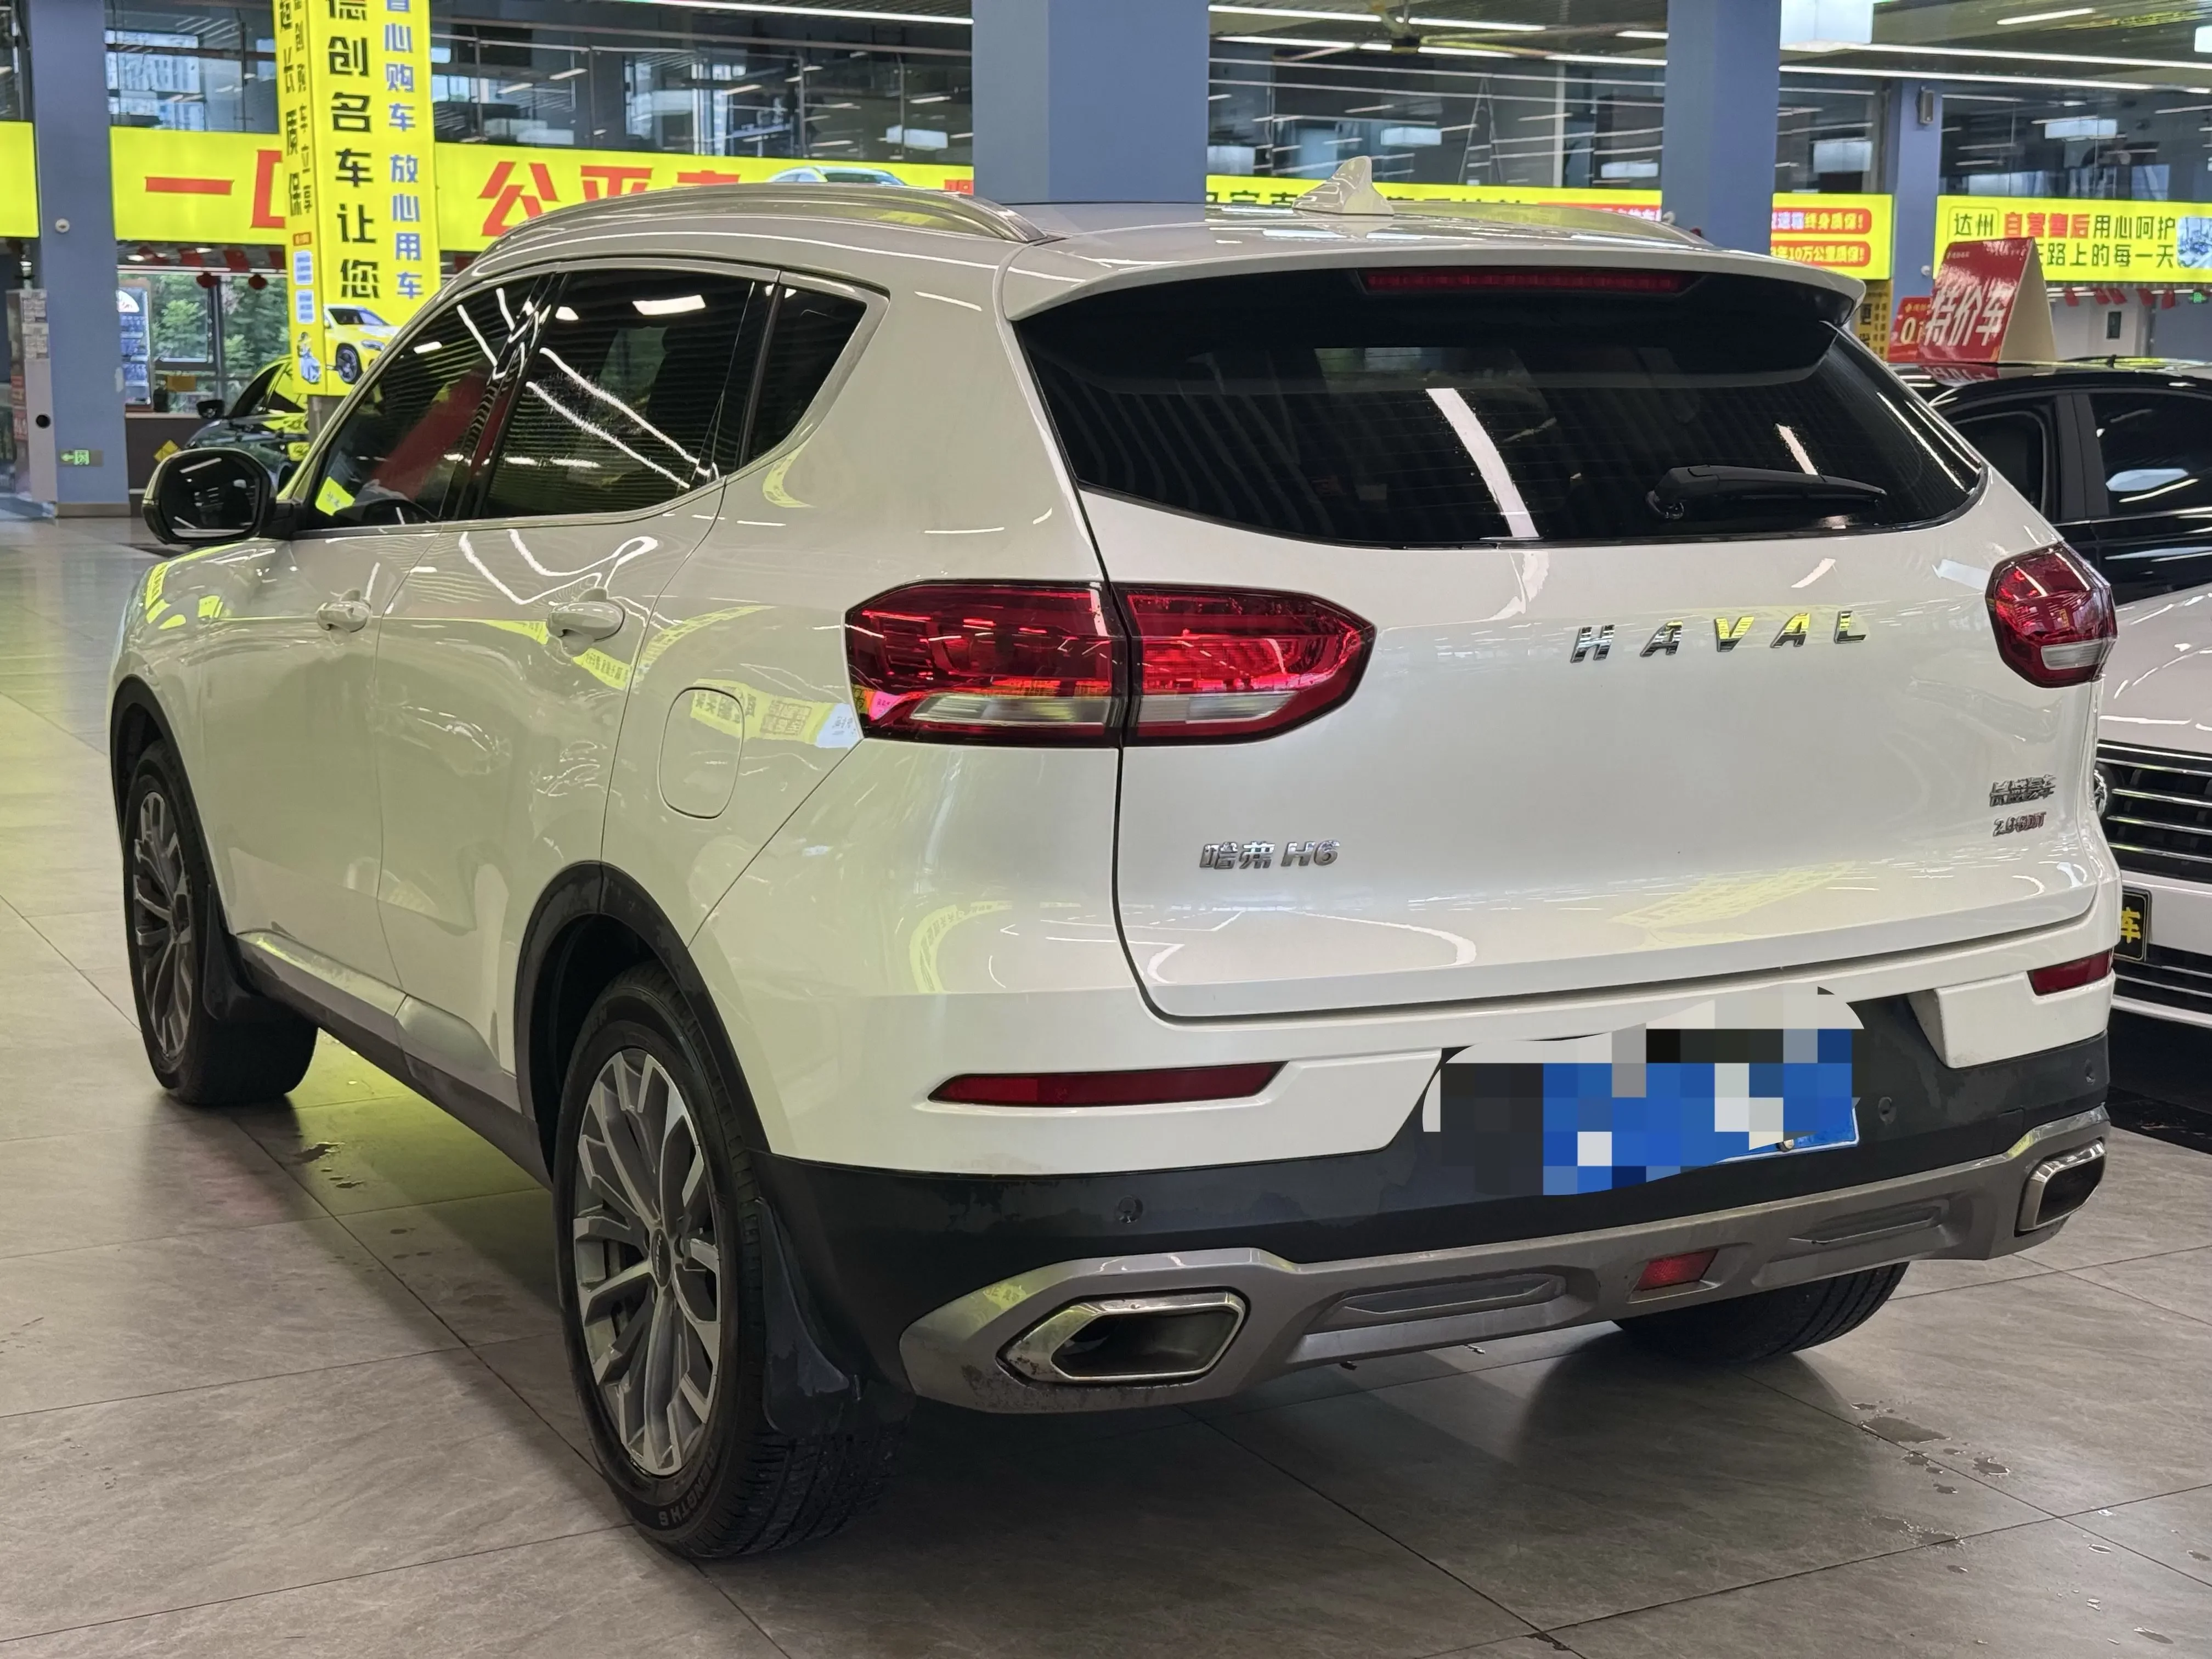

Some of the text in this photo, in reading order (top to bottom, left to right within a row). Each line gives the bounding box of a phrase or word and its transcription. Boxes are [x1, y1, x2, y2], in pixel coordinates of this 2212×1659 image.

[1954, 213, 1994, 236] 达州
[1924, 284, 2014, 346] 特价车
[1570, 610, 1867, 663] HAVAL
[1199, 839, 1341, 870] 哈弗 H6
